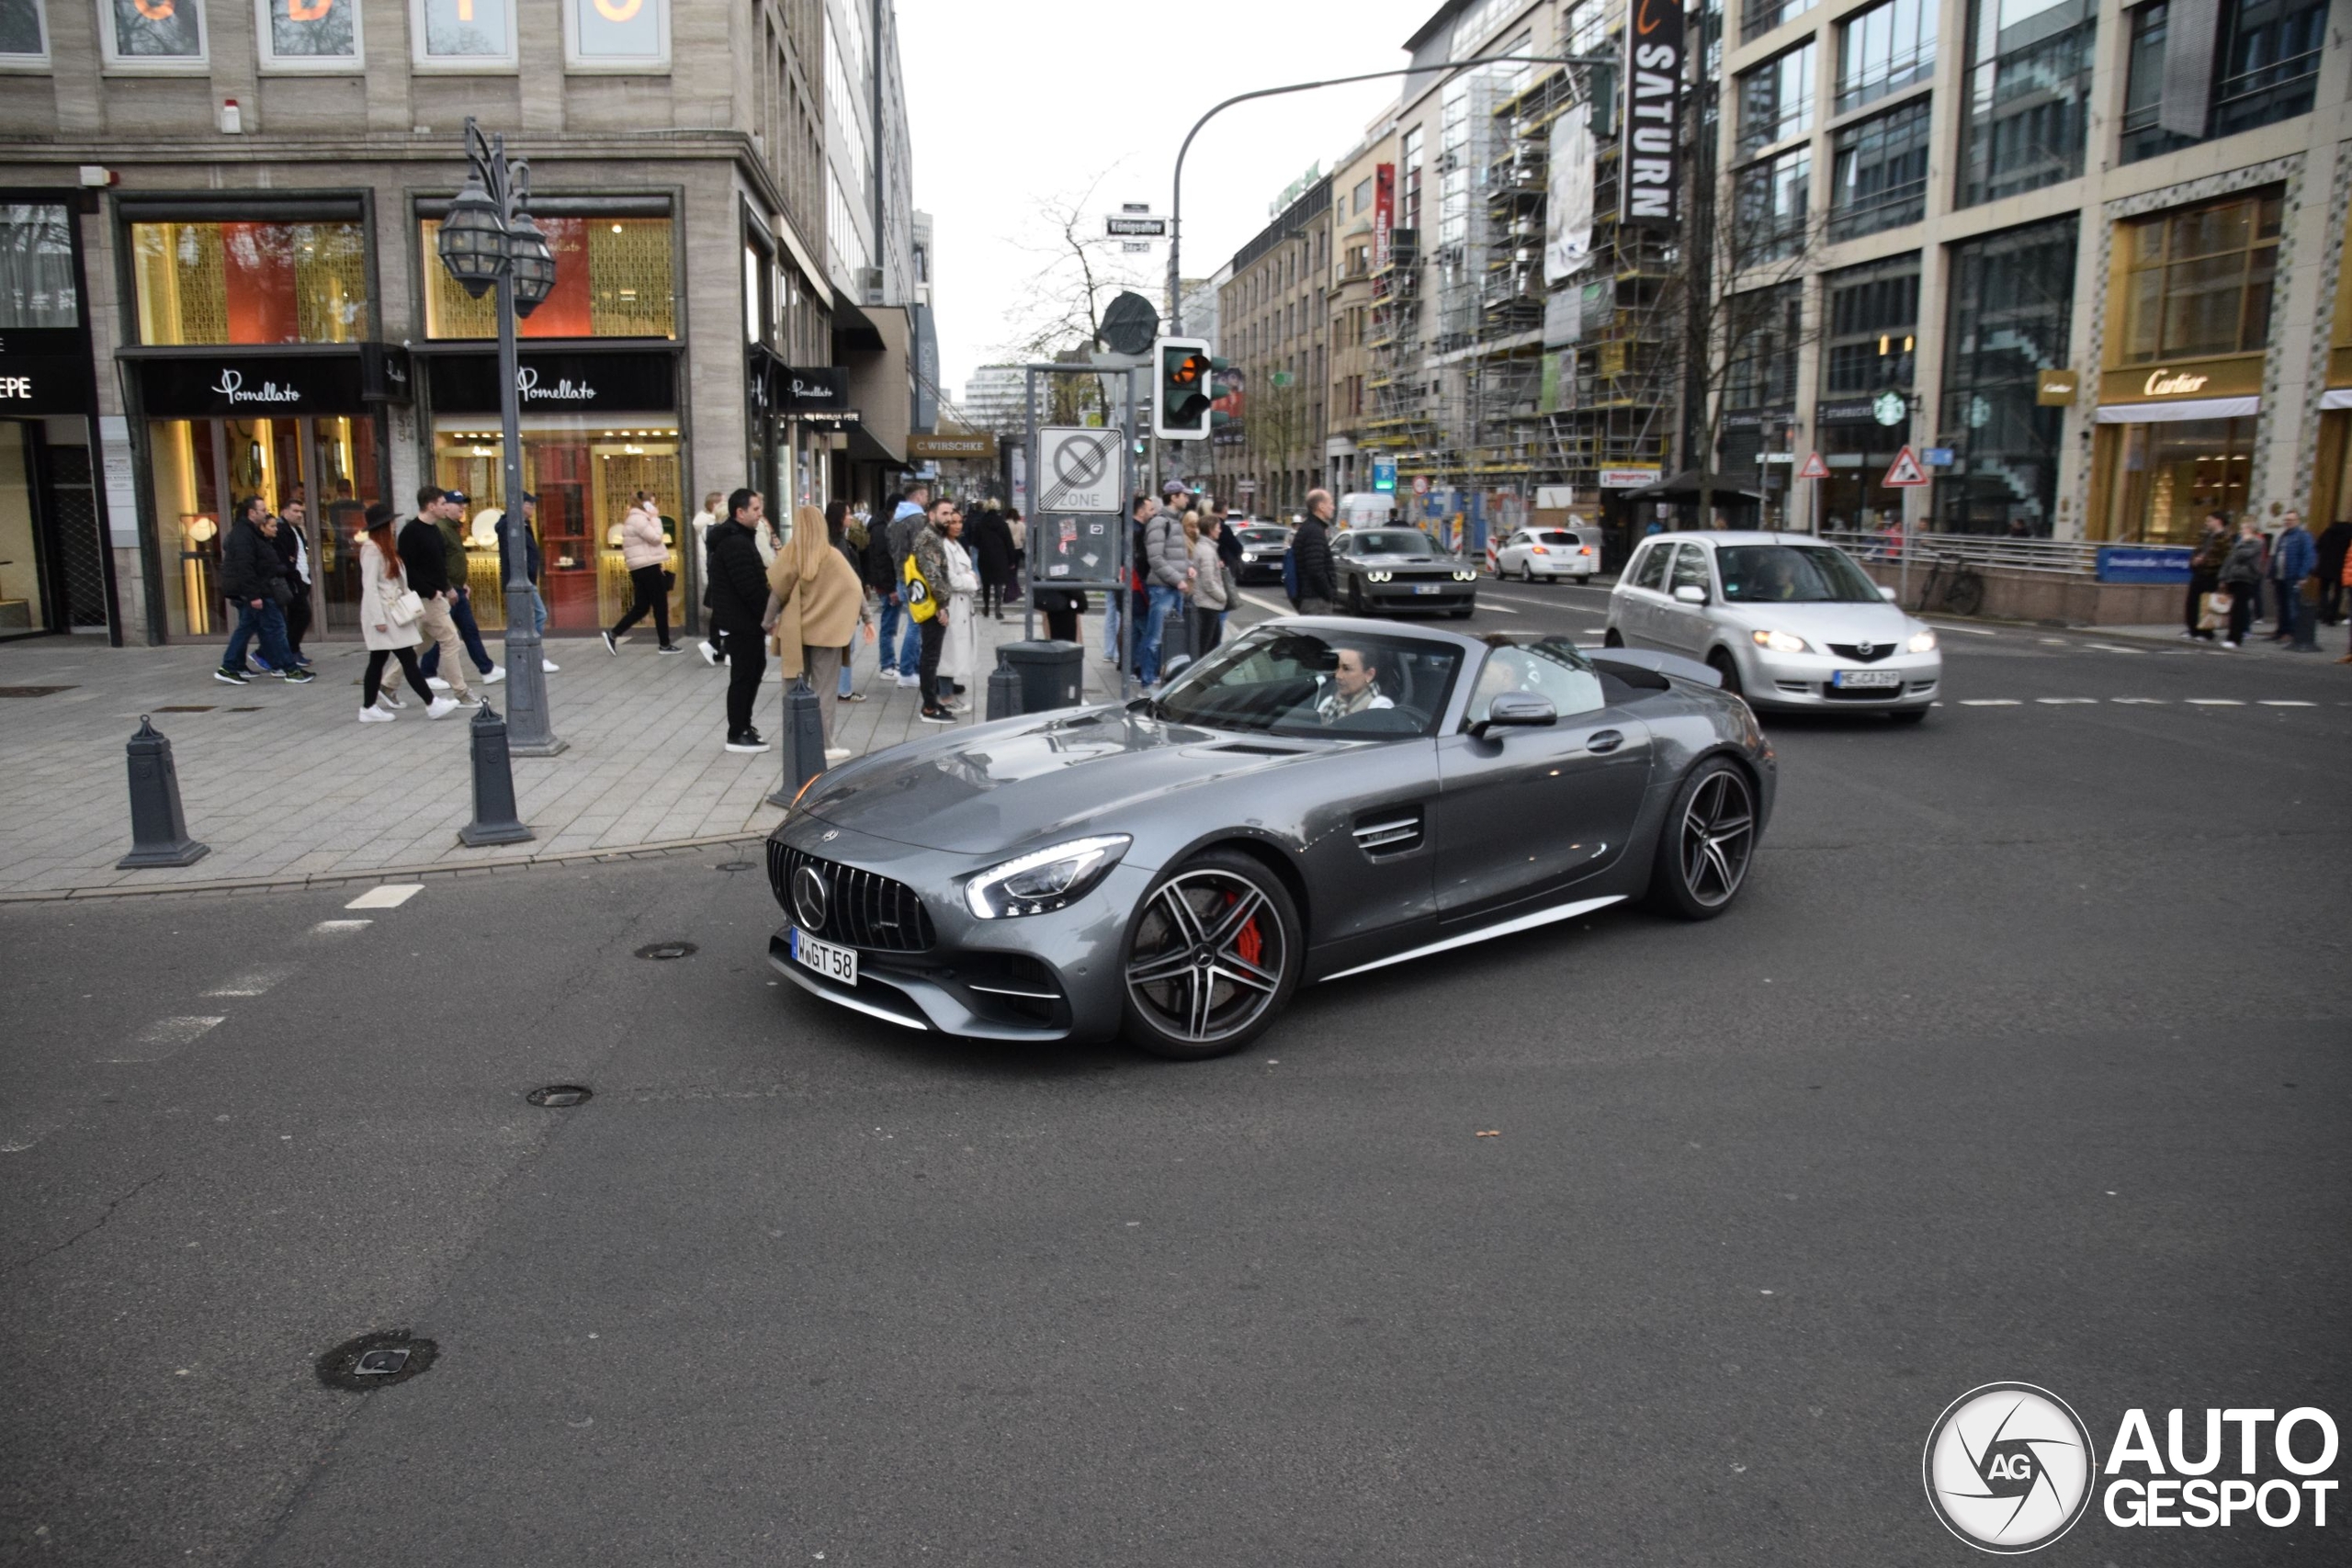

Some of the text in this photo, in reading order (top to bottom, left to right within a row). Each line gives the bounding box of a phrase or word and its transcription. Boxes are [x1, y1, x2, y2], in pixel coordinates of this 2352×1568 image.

[1631, 43, 1676, 217] SATURN
[1111, 220, 1162, 234] Königsallee
[211, 368, 301, 404] Pomellato
[518, 366, 596, 401] Pomellato
[2143, 368, 2208, 396] Cartier
[1059, 493, 1101, 506] ZONE
[798, 934, 853, 979] W GT 58
